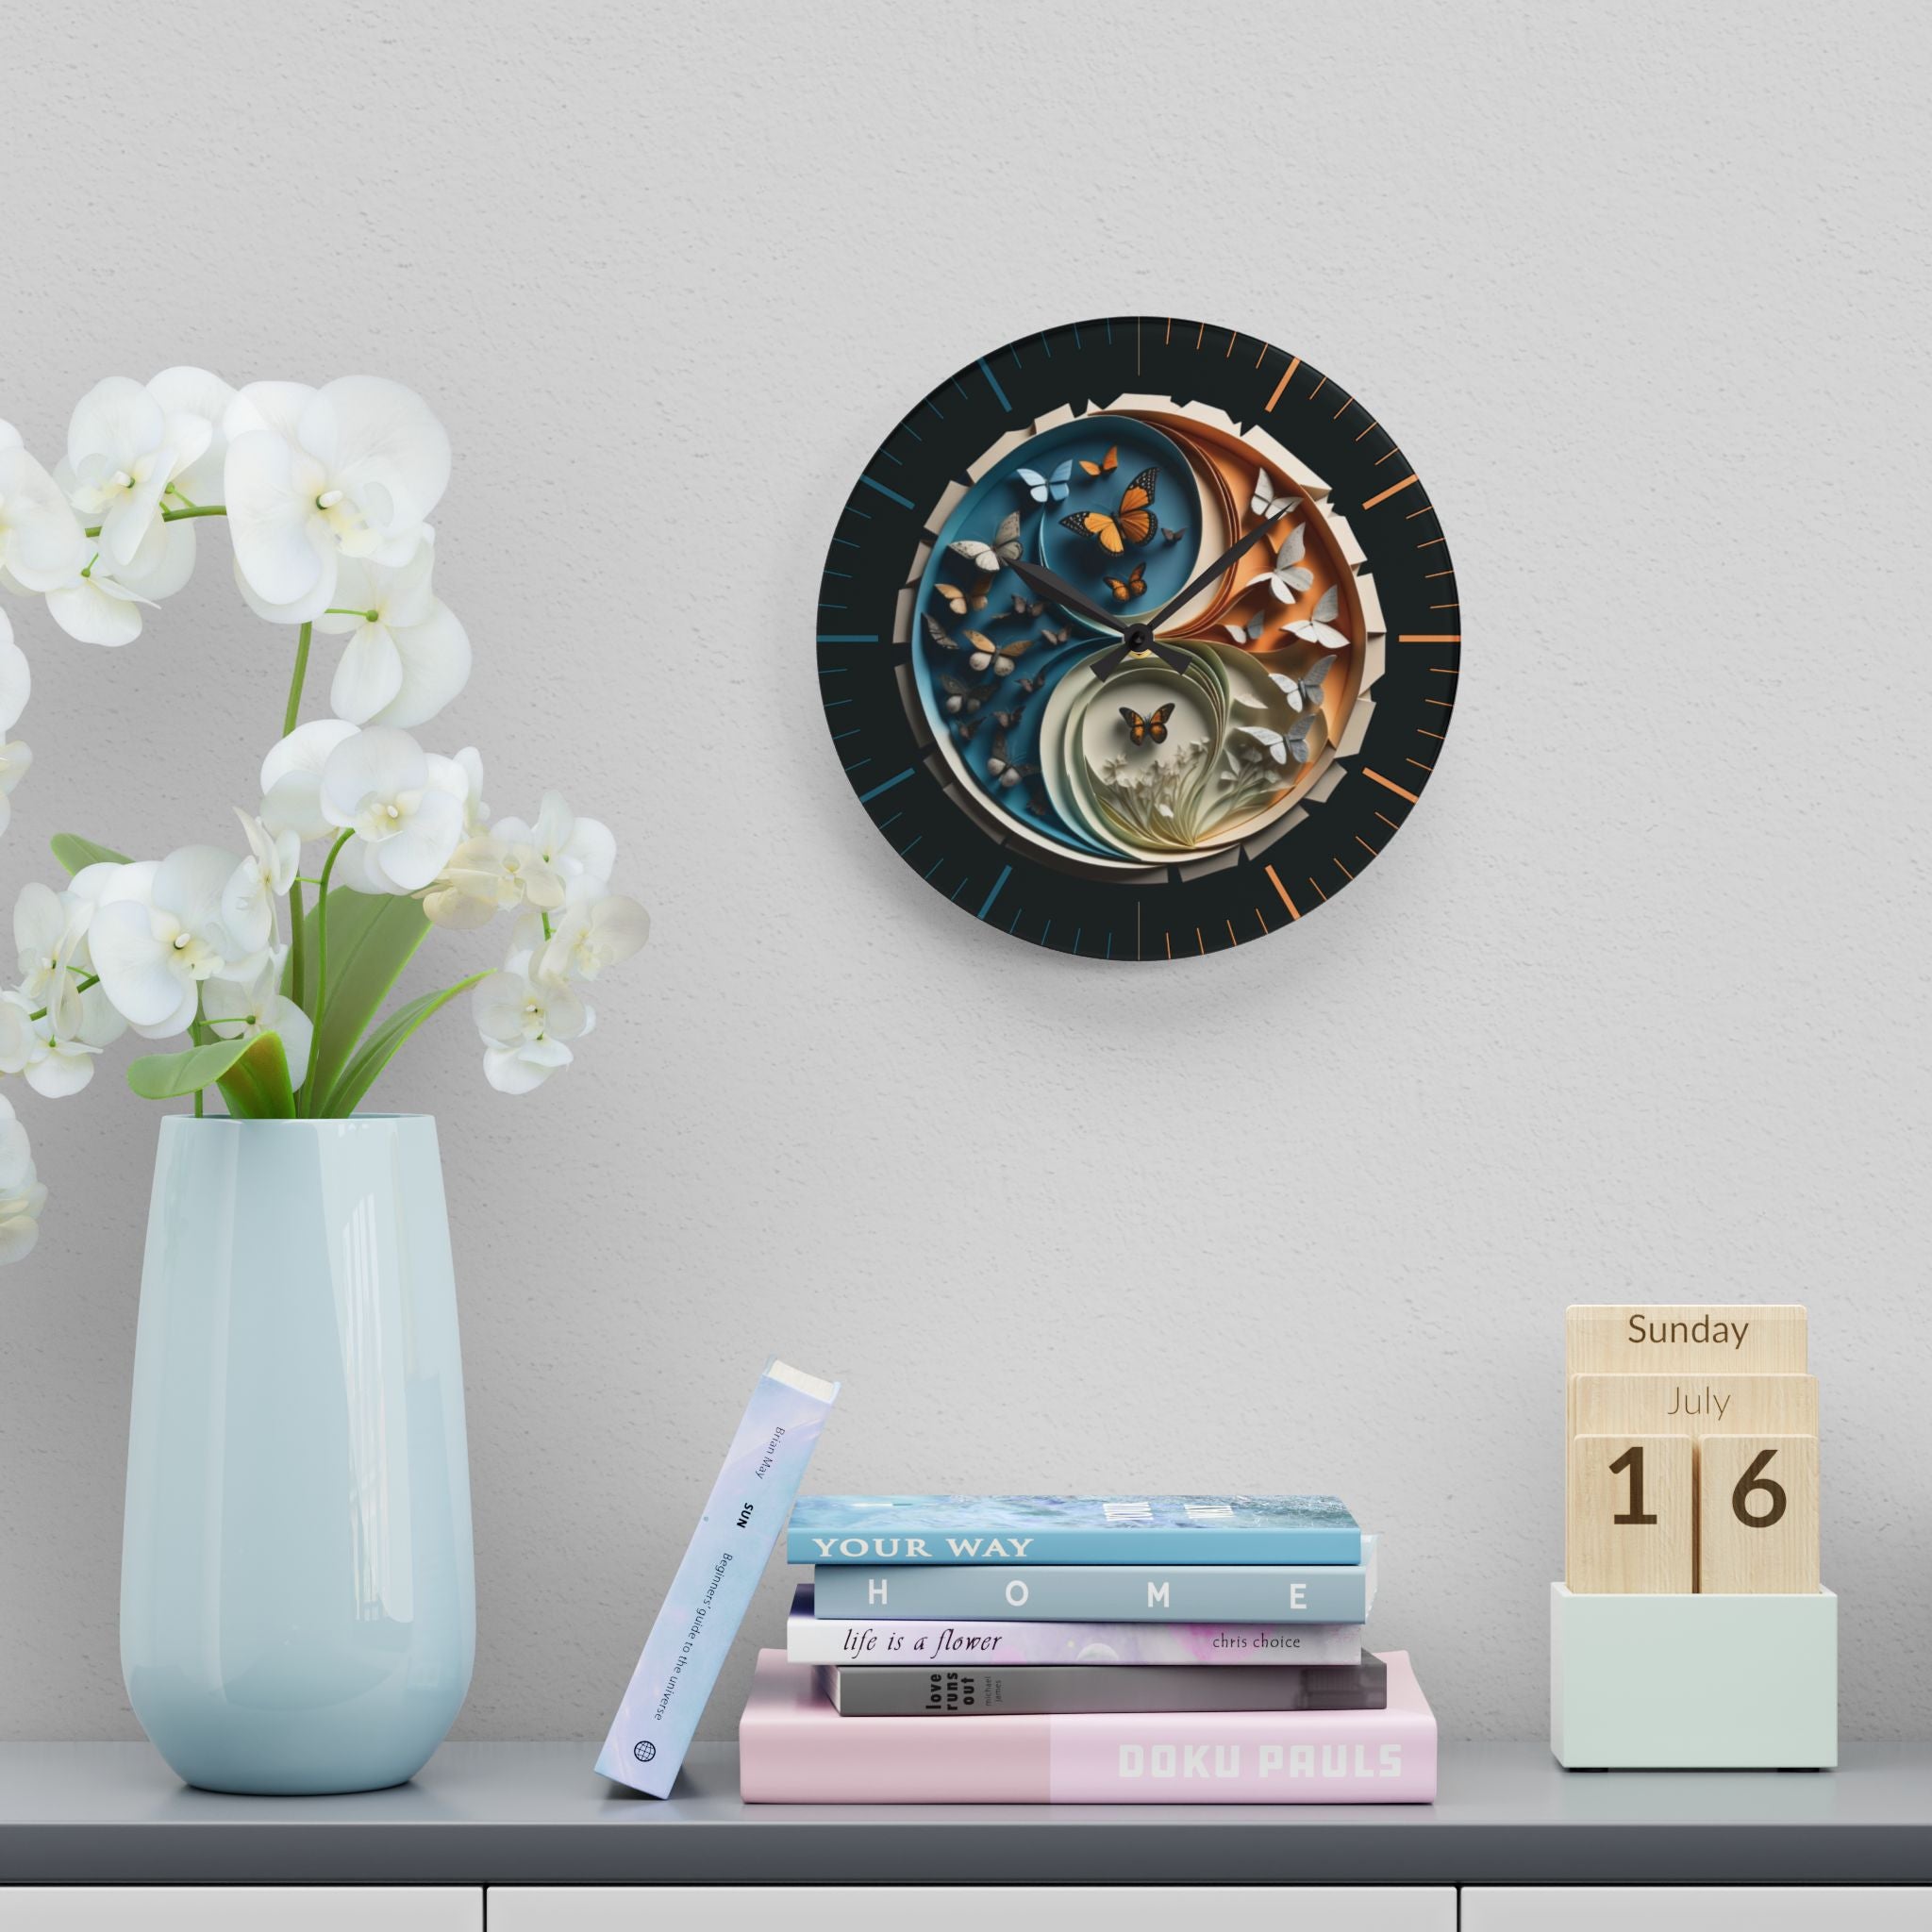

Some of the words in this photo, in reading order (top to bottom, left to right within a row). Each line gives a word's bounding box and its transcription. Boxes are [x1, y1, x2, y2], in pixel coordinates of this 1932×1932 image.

[1628, 1313, 1749, 1350] Sunday
[1667, 1386, 1732, 1421] July
[766, 1426, 786, 1455] Brian
[755, 1456, 774, 1480] May
[736, 1502, 754, 1529] SUN
[811, 1538, 933, 1557] YOUR
[945, 1538, 1035, 1557] WAY
[688, 1607, 707, 1640] guide
[682, 1642, 693, 1654] to
[842, 1628, 878, 1659] life
[887, 1631, 905, 1651] is
[912, 1635, 928, 1651] a
[929, 1628, 1003, 1659] flower
[1212, 1633, 1247, 1649] chris
[1253, 1633, 1301, 1649] choice
[673, 1656, 688, 1674] the
[654, 1675, 679, 1722] universe
[925, 1674, 941, 1709] love
[946, 1673, 958, 1711] runs
[960, 1676, 974, 1706] out
[1118, 1744, 1241, 1779] DOKU
[1258, 1744, 1403, 1778] PAULS
